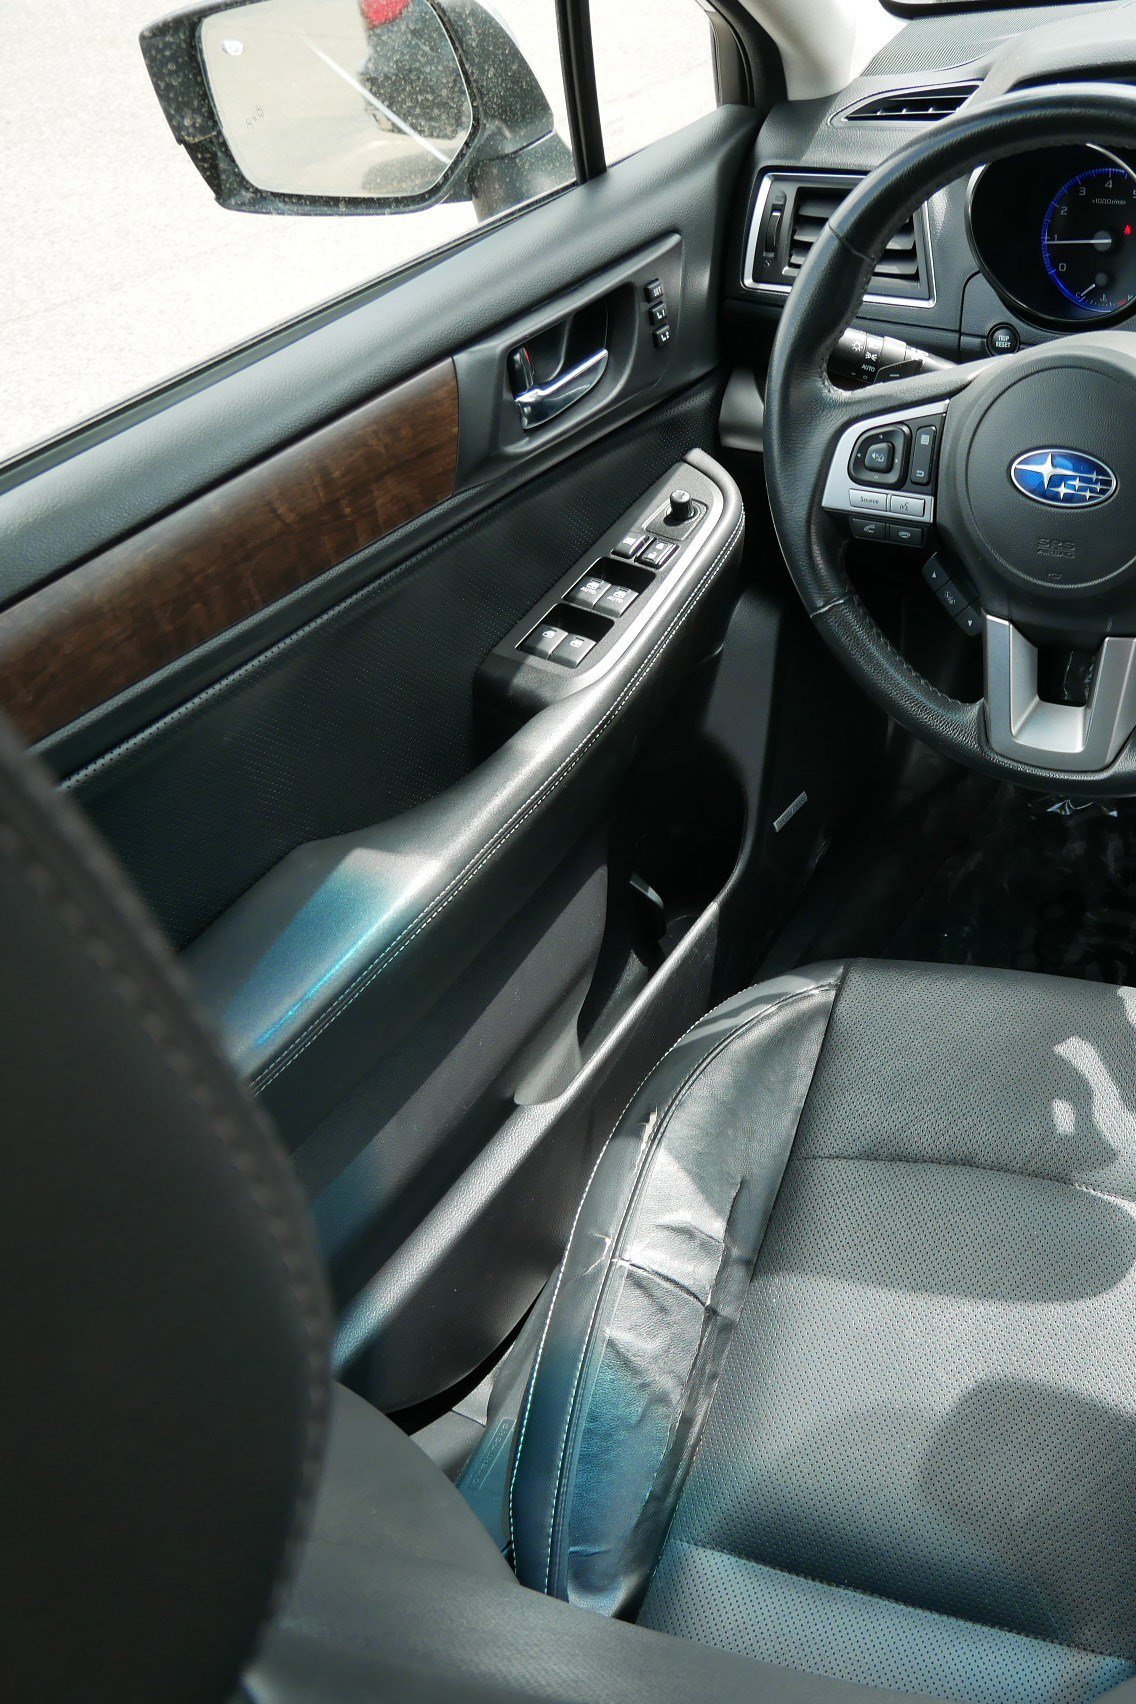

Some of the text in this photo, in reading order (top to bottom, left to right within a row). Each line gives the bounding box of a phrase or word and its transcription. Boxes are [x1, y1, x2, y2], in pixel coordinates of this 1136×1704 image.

[1105, 180, 1113, 189] 4
[1079, 187, 1086, 196] 3
[1060, 206, 1068, 215] 2
[1059, 263, 1066, 272] 0
[862, 364, 876, 372] AUTO
[860, 496, 879, 505] Source
[580, 587, 597, 595] AUTO
